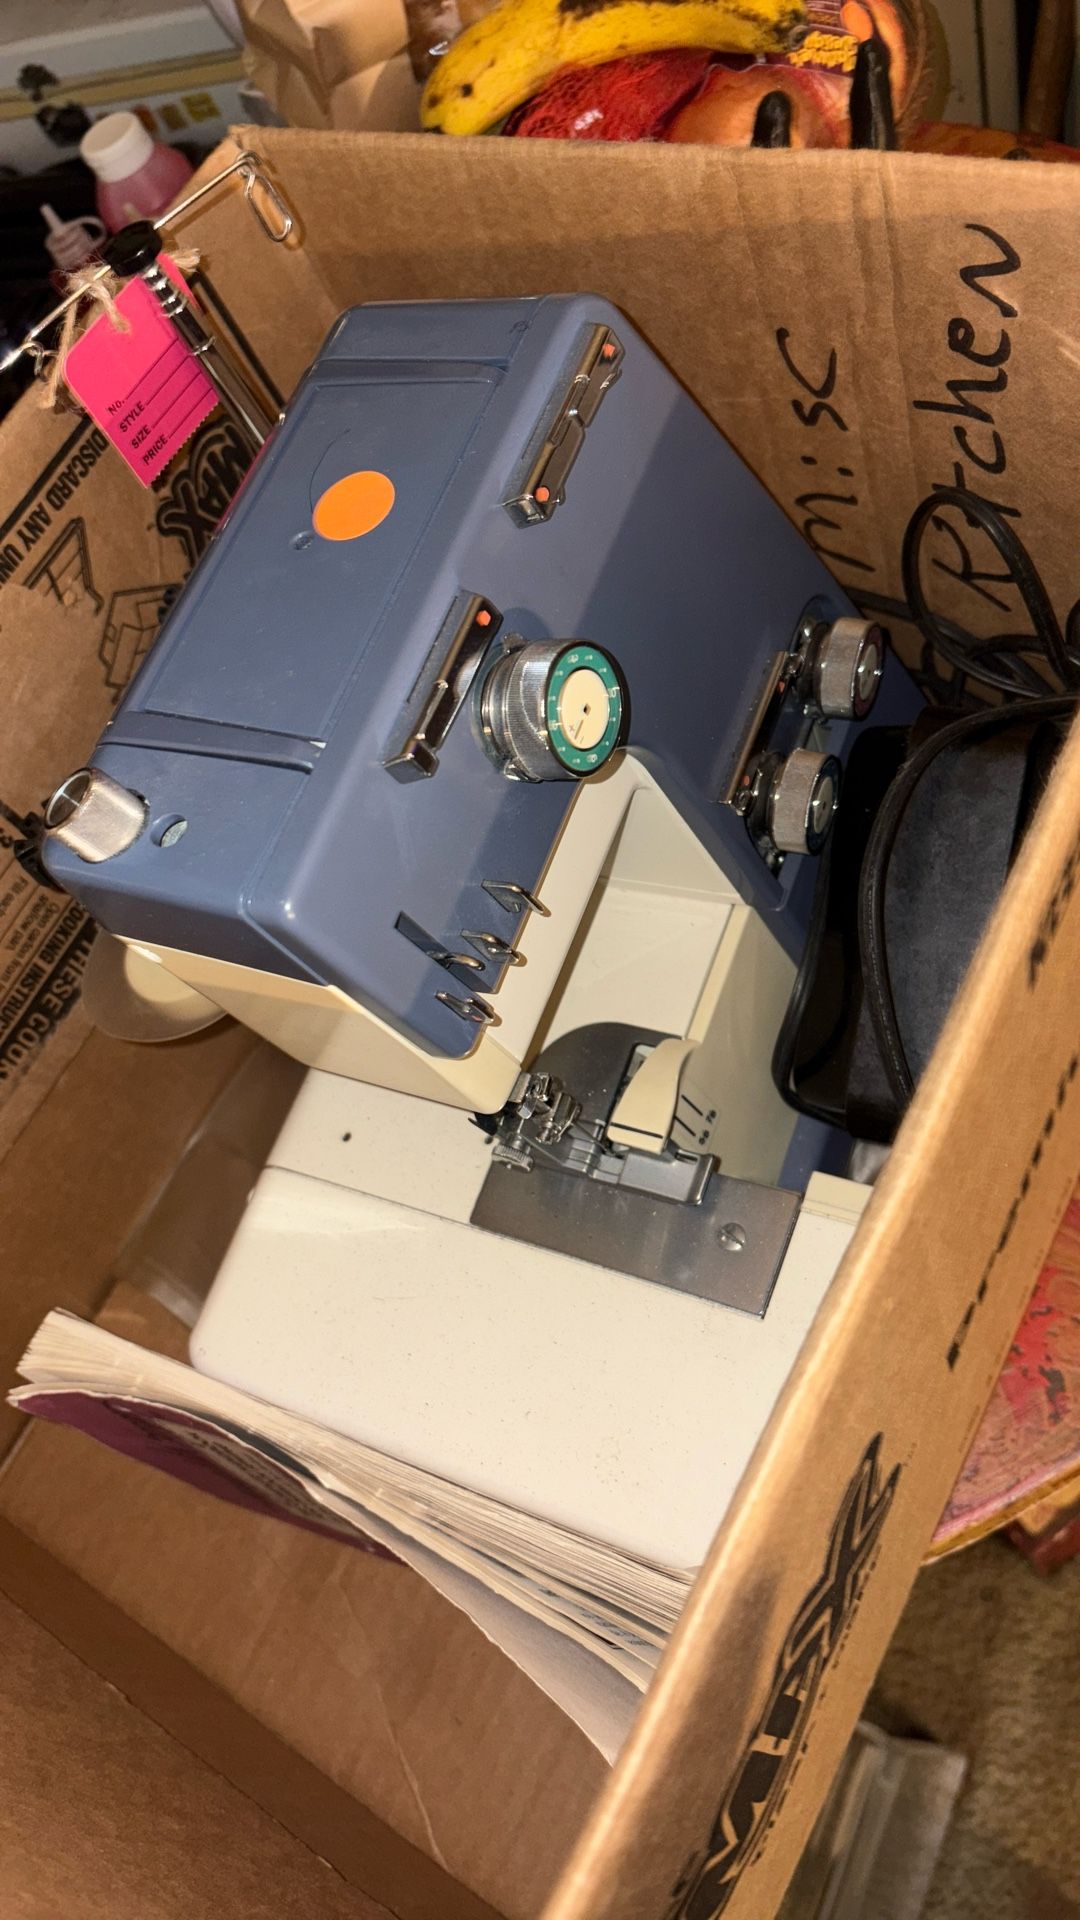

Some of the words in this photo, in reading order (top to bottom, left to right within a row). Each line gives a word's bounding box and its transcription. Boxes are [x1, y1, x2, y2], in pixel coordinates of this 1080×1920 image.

[119, 402, 146, 433] STYLE
[131, 424, 152, 449] SIZE
[46, 429, 109, 512] DISCARD
[142, 434, 169, 466] PRICE
[17, 505, 53, 549] ANY
[0, 541, 25, 585] UN
[38, 901, 88, 966] OOKING
[0, 962, 47, 1036] INSTRUC
